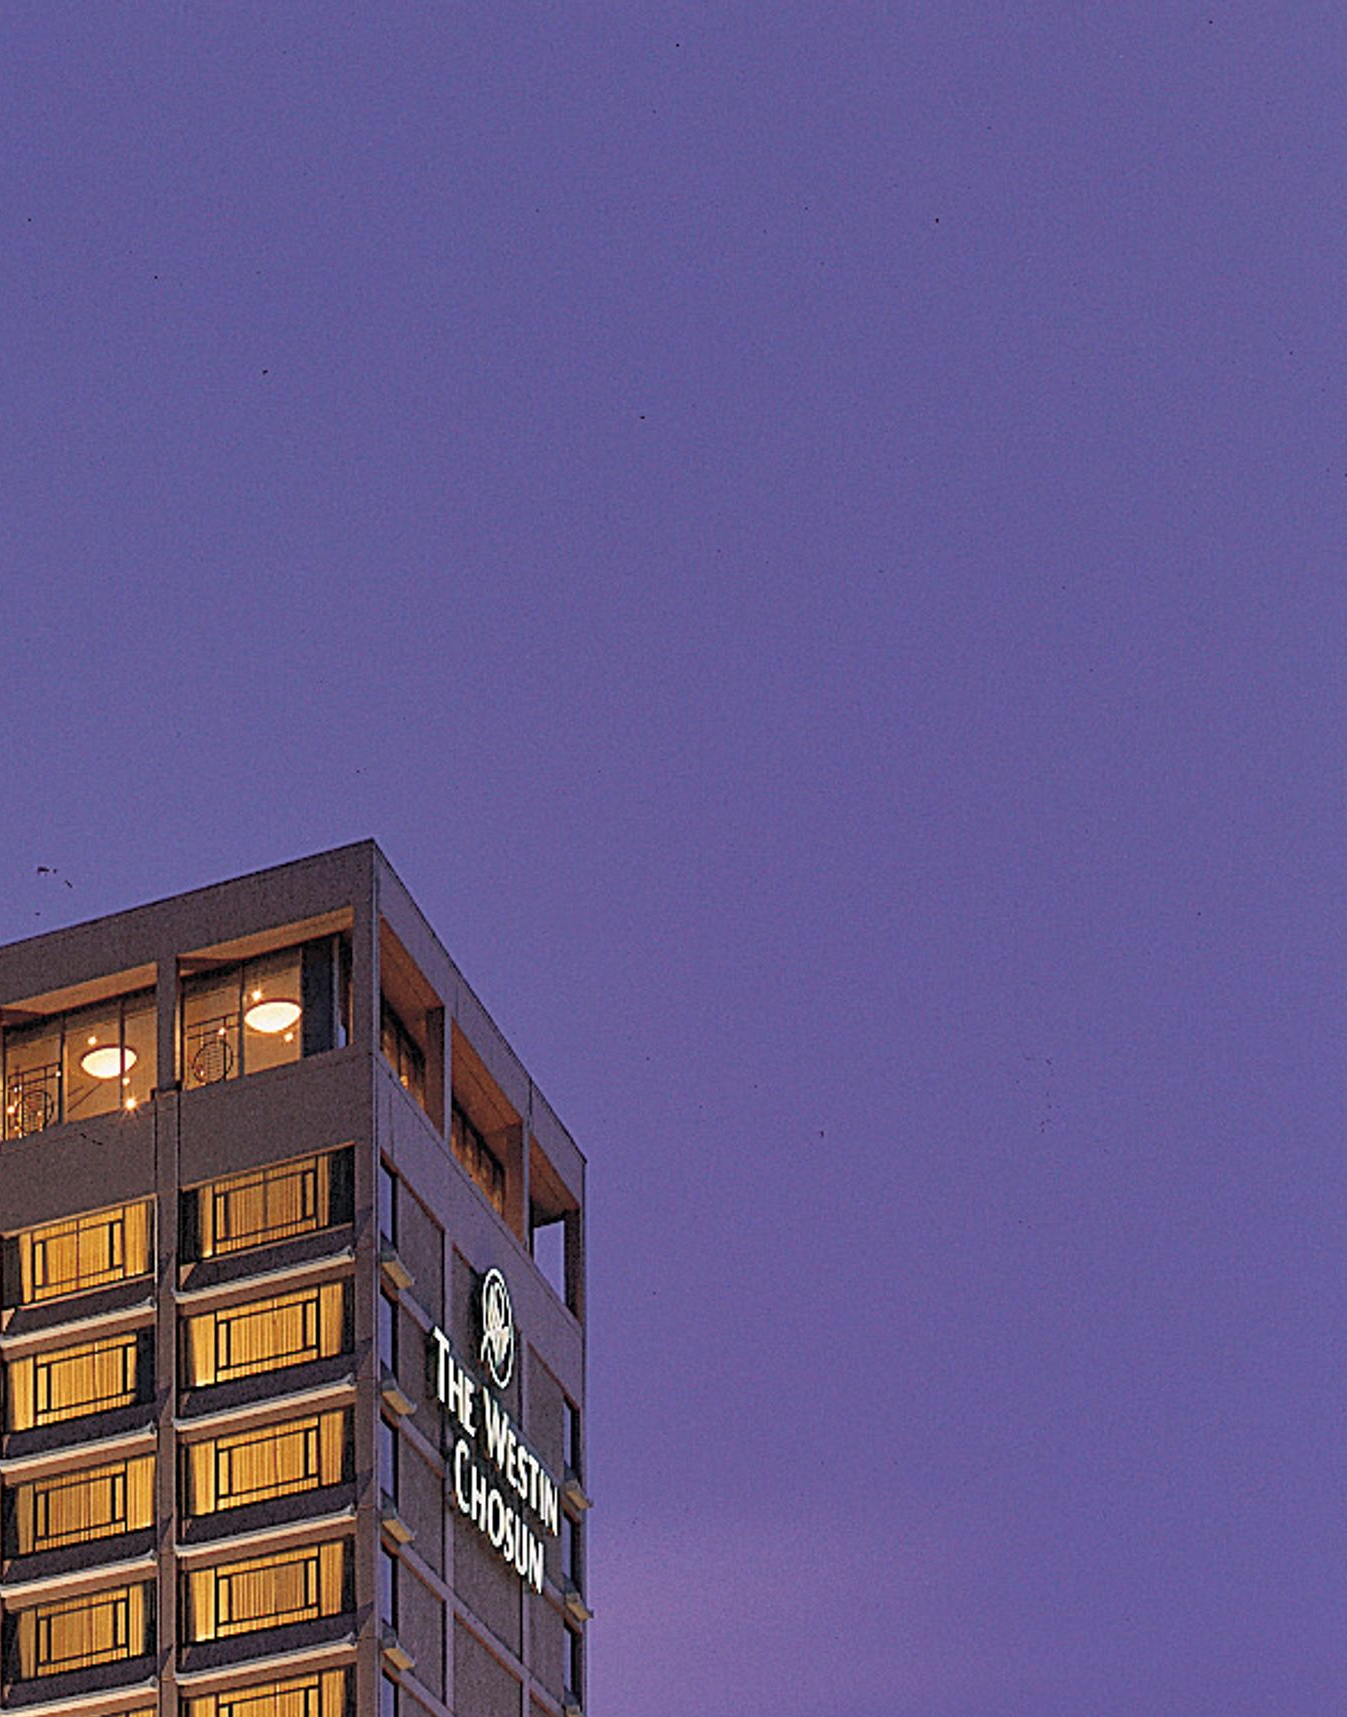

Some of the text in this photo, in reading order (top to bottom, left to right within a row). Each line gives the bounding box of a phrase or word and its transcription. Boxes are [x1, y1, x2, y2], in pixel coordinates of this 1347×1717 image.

[431, 1325, 559, 1537] THE WESTIN
[454, 1438, 544, 1595] CHOSUN
